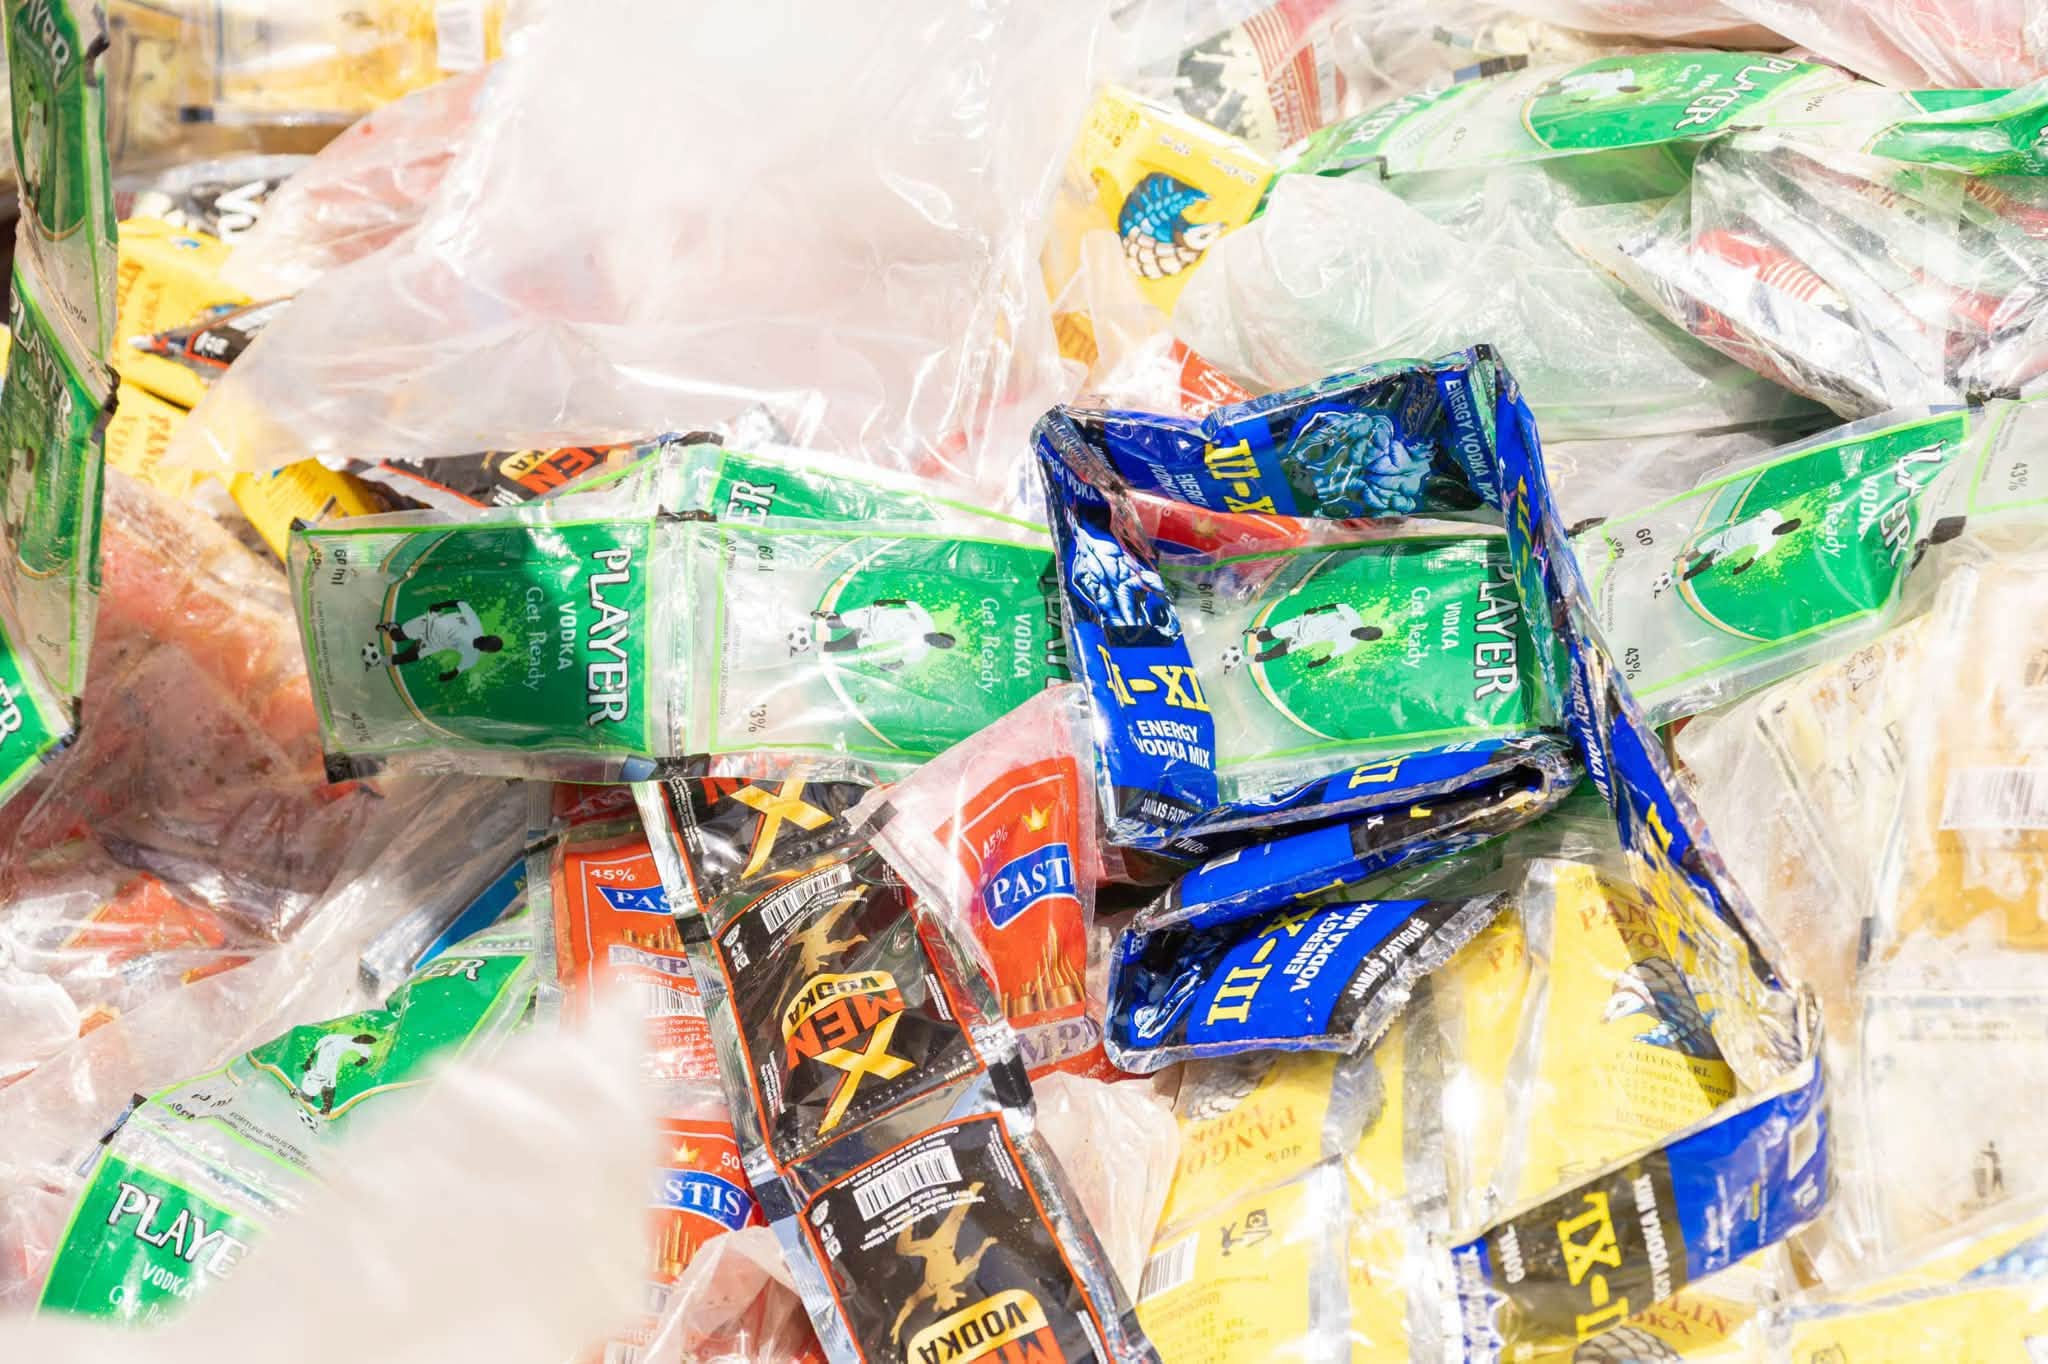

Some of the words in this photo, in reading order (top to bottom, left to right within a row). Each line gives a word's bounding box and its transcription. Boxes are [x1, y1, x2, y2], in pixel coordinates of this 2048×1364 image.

[526, 585, 545, 624] Get
[980, 597, 1000, 625] Get
[1411, 586, 1432, 613] Get
[1440, 600, 1463, 651] VODKA
[556, 600, 578, 672] VODKA
[588, 547, 634, 729] PLAYER
[1013, 613, 1033, 679] VODKA
[1402, 617, 1430, 669] Ready
[1473, 562, 1522, 700] PLAYER
[521, 630, 547, 692] Ready
[975, 631, 1000, 694] Ready
[1624, 646, 1643, 680] 43%
[1133, 737, 1188, 762] VODKA
[1189, 746, 1211, 770] MIX
[1136, 720, 1199, 744] ENERGY
[588, 867, 637, 883] 45%
[614, 890, 672, 915] PAS
[1283, 911, 1345, 977] ENERGY
[1290, 928, 1352, 993] VODKA
[1342, 902, 1379, 941] MIX
[788, 974, 881, 1027] VODKA
[787, 991, 906, 1070] MEN
[664, 1179, 742, 1218] STIS
[107, 1181, 250, 1280] PLAYE
[918, 1300, 1029, 1364] VODKA
